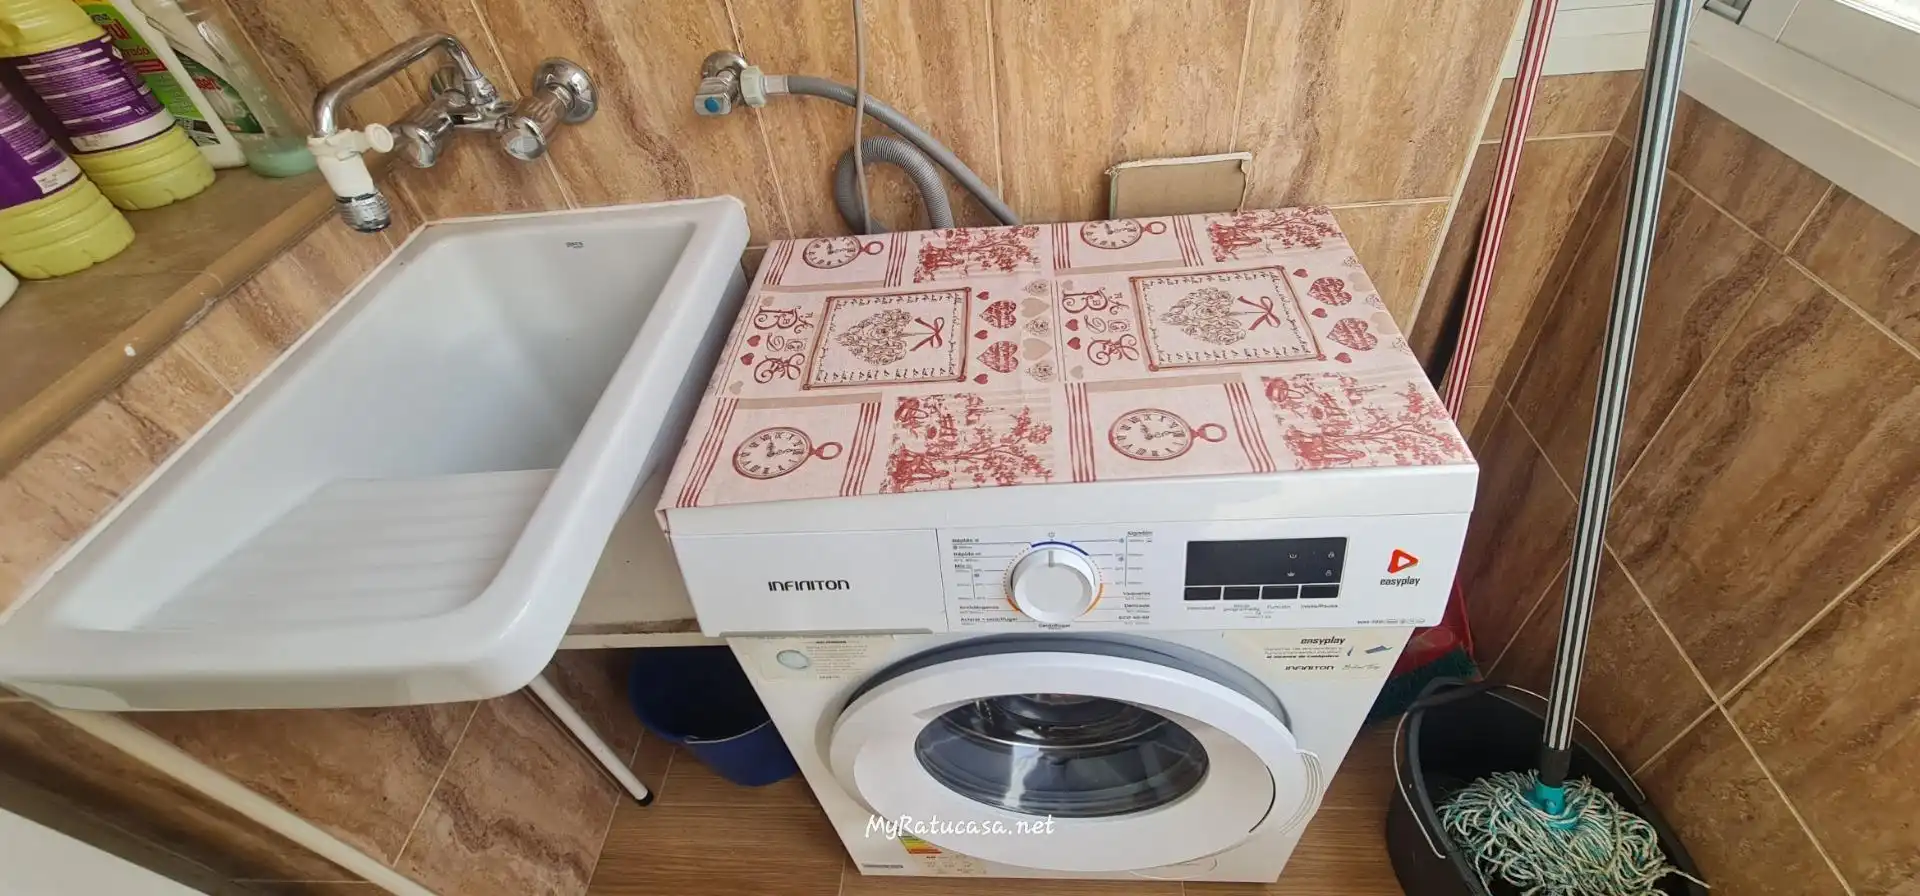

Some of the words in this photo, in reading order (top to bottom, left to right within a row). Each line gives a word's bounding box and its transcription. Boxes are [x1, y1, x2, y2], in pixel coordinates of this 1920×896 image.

[768, 579, 850, 592] INFINITON
[1380, 576, 1421, 587] easyplay
[1300, 635, 1346, 646] easyplay
